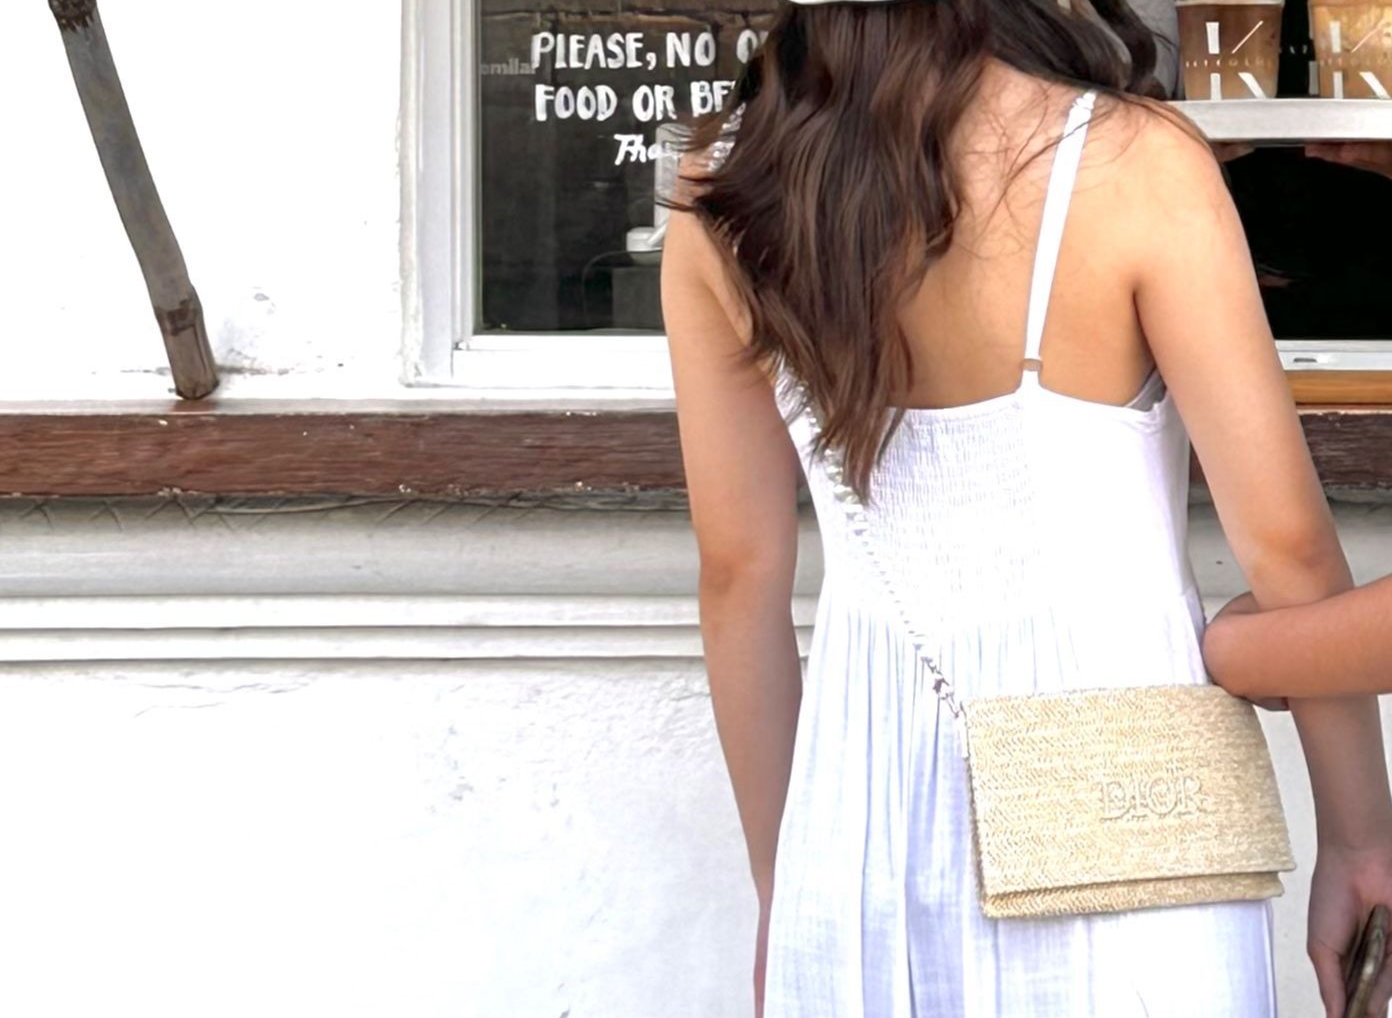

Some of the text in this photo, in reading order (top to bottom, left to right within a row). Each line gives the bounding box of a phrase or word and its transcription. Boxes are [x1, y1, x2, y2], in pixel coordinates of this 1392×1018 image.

[530, 31, 657, 70] PLEASE,
[667, 31, 716, 69] NO
[534, 84, 618, 121] FOOD
[632, 85, 677, 121] OR
